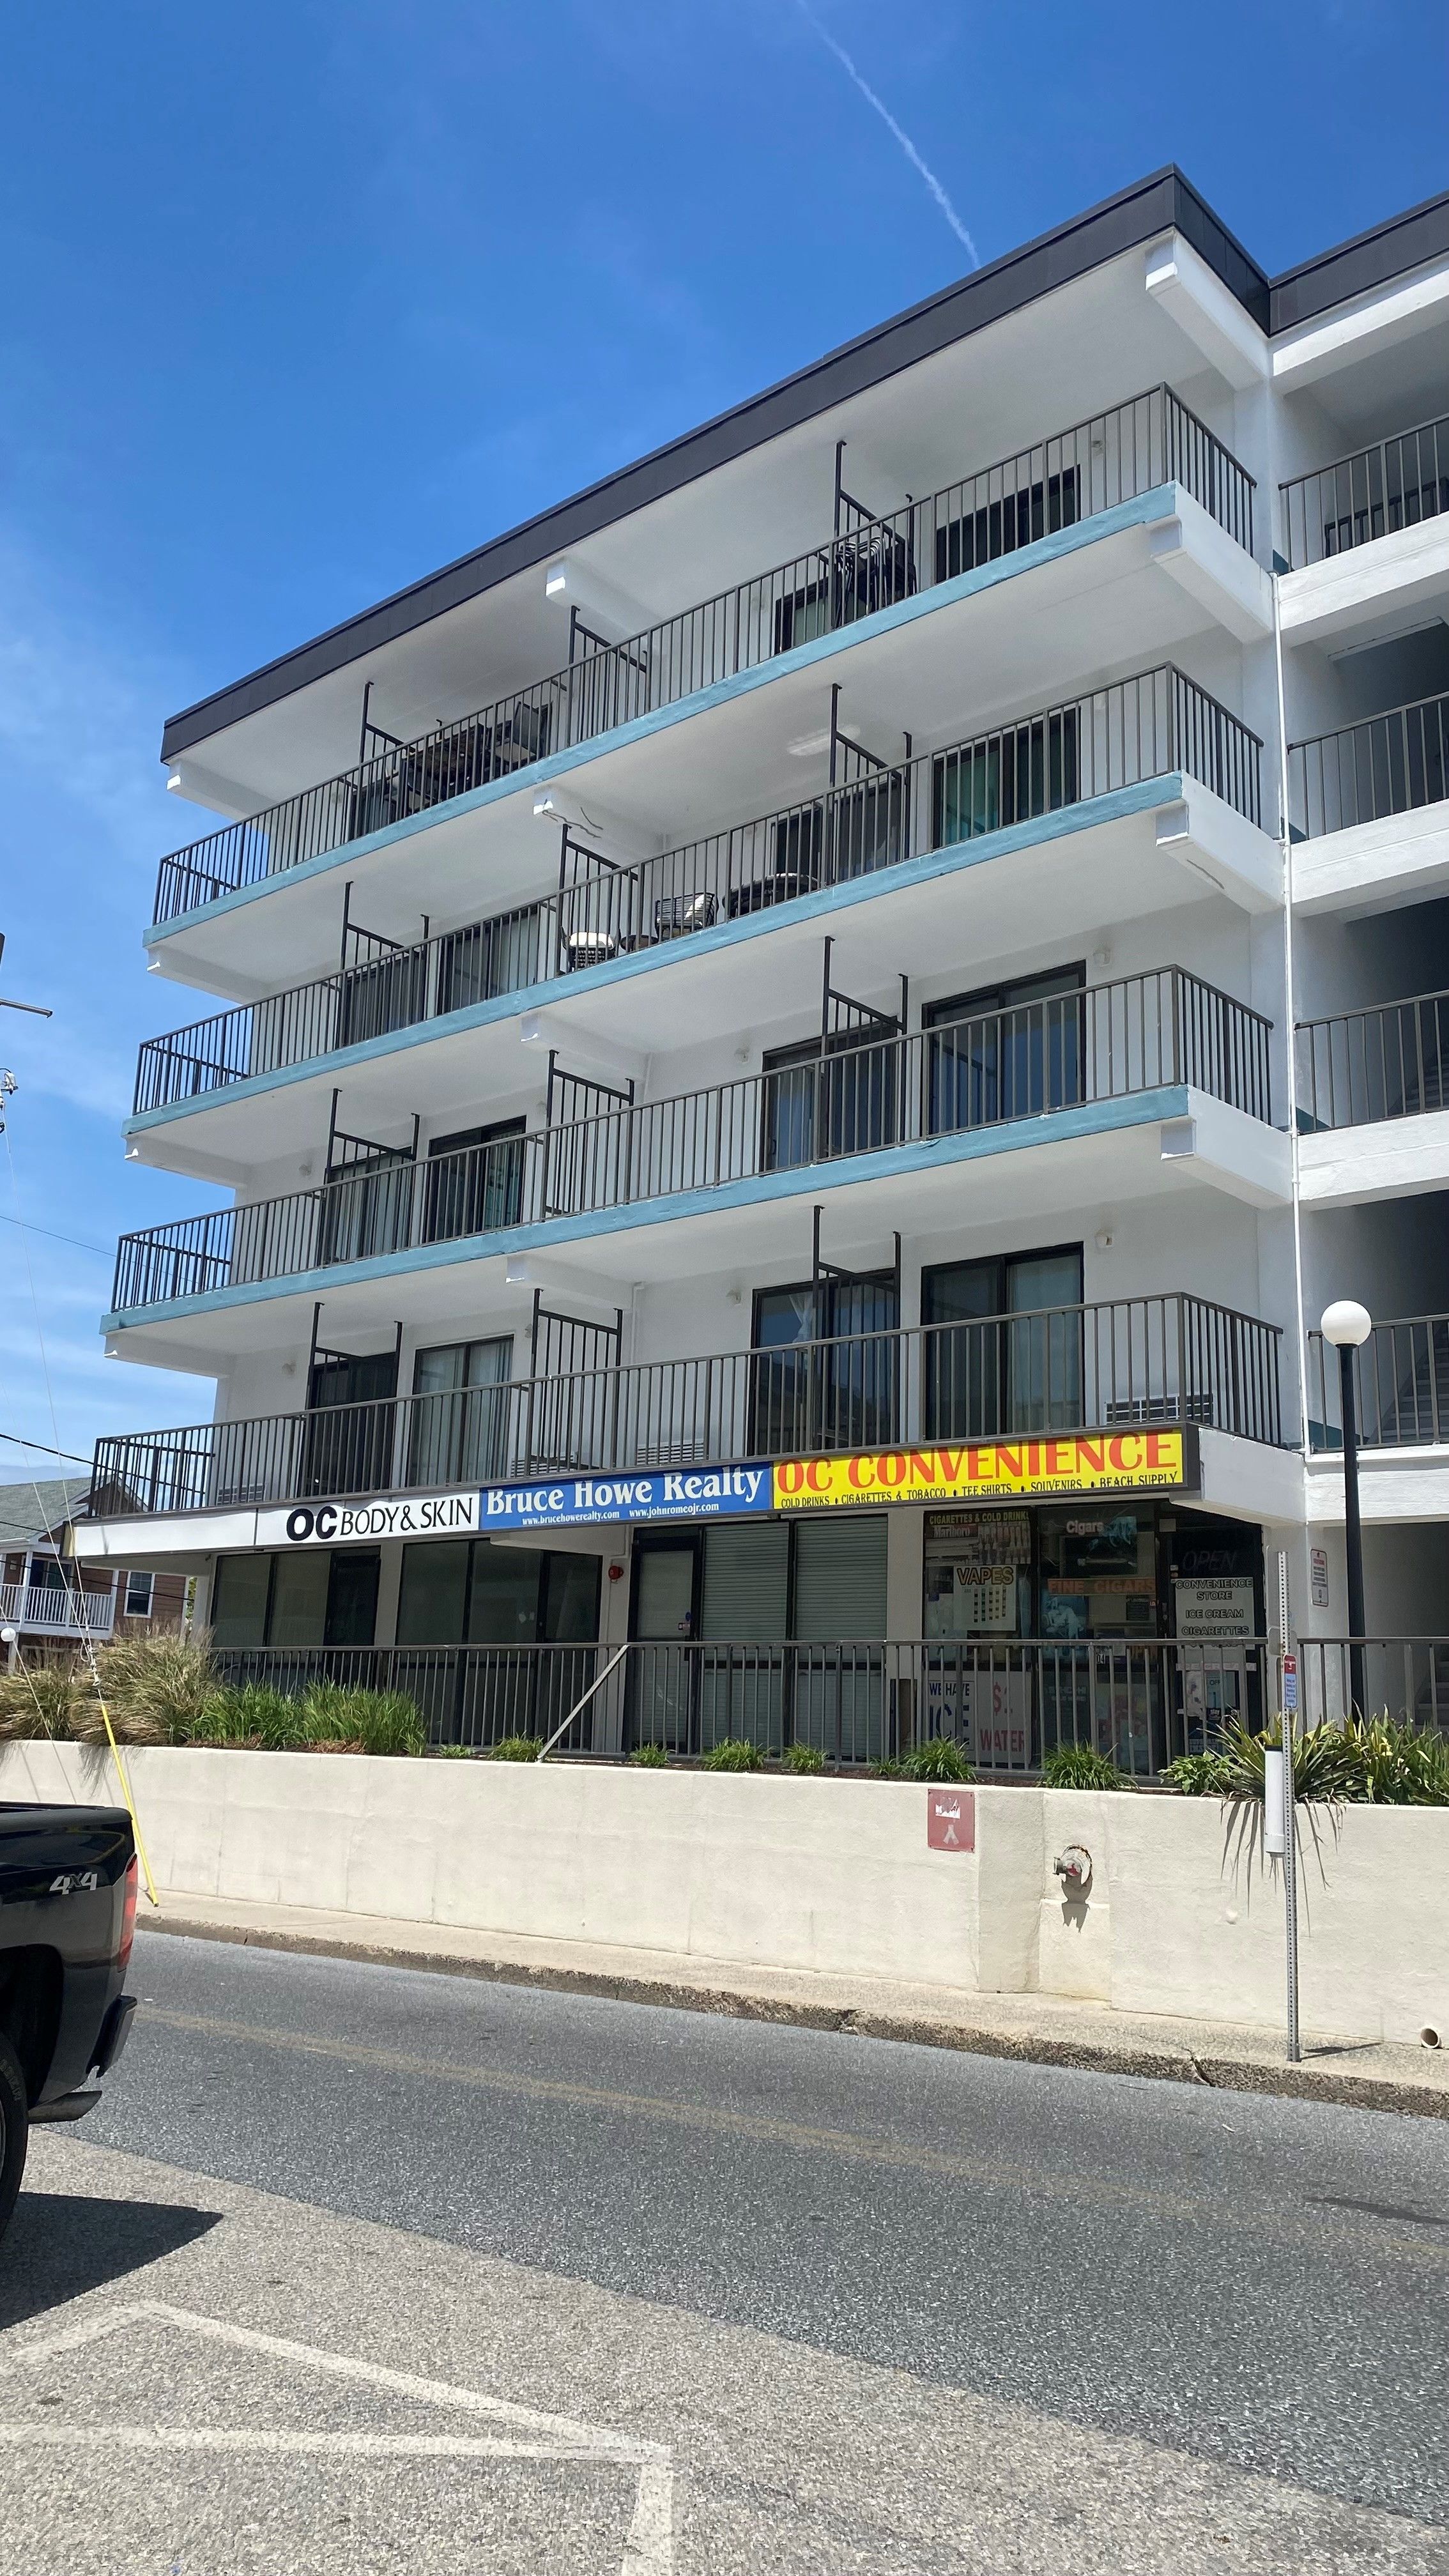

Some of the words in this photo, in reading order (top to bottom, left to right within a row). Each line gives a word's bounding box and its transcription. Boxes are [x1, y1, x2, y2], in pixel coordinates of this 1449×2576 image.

[778, 1457, 833, 1493] OC
[848, 1429, 1177, 1489] CONVENIENCE
[486, 1489, 565, 1515] Bruce
[574, 1480, 652, 1508] Howe
[663, 1466, 764, 1503] Realty
[781, 1498, 799, 1508] COLD
[802, 1496, 829, 1506] DRINKS
[841, 1491, 892, 1504] CIGARETTES
[896, 1491, 902, 1499] &
[907, 1487, 946, 1499] TOBACCO
[962, 1485, 979, 1496] TEE
[981, 1483, 1012, 1494] SHIRTS
[1031, 1478, 1082, 1492] SOUVENIRS
[1100, 1476, 1133, 1487] BEACH
[1138, 1471, 1178, 1485] SUPPLY
[286, 1505, 337, 1541] OC
[420, 1497, 473, 1528] SKIN
[522, 1510, 620, 1526] www.brucehowerealty.com
[629, 1502, 720, 1518] www.johnromeojr.com
[930, 1514, 973, 1525] CIGARETTES
[974, 1514, 980, 1523] &
[982, 1512, 1001, 1522] COLD
[1066, 1520, 1104, 1535] Cigars
[1182, 1550, 1237, 1572] OPEN
[957, 1566, 1014, 1586] VAPES
[1175, 1579, 1253, 1590] CONVENIENCE
[1197, 1591, 1233, 1600] STORE
[1185, 1609, 1202, 1619] ICE
[1205, 1609, 1244, 1619] CREAM
[1181, 1626, 1250, 1636] CIGARETTES
